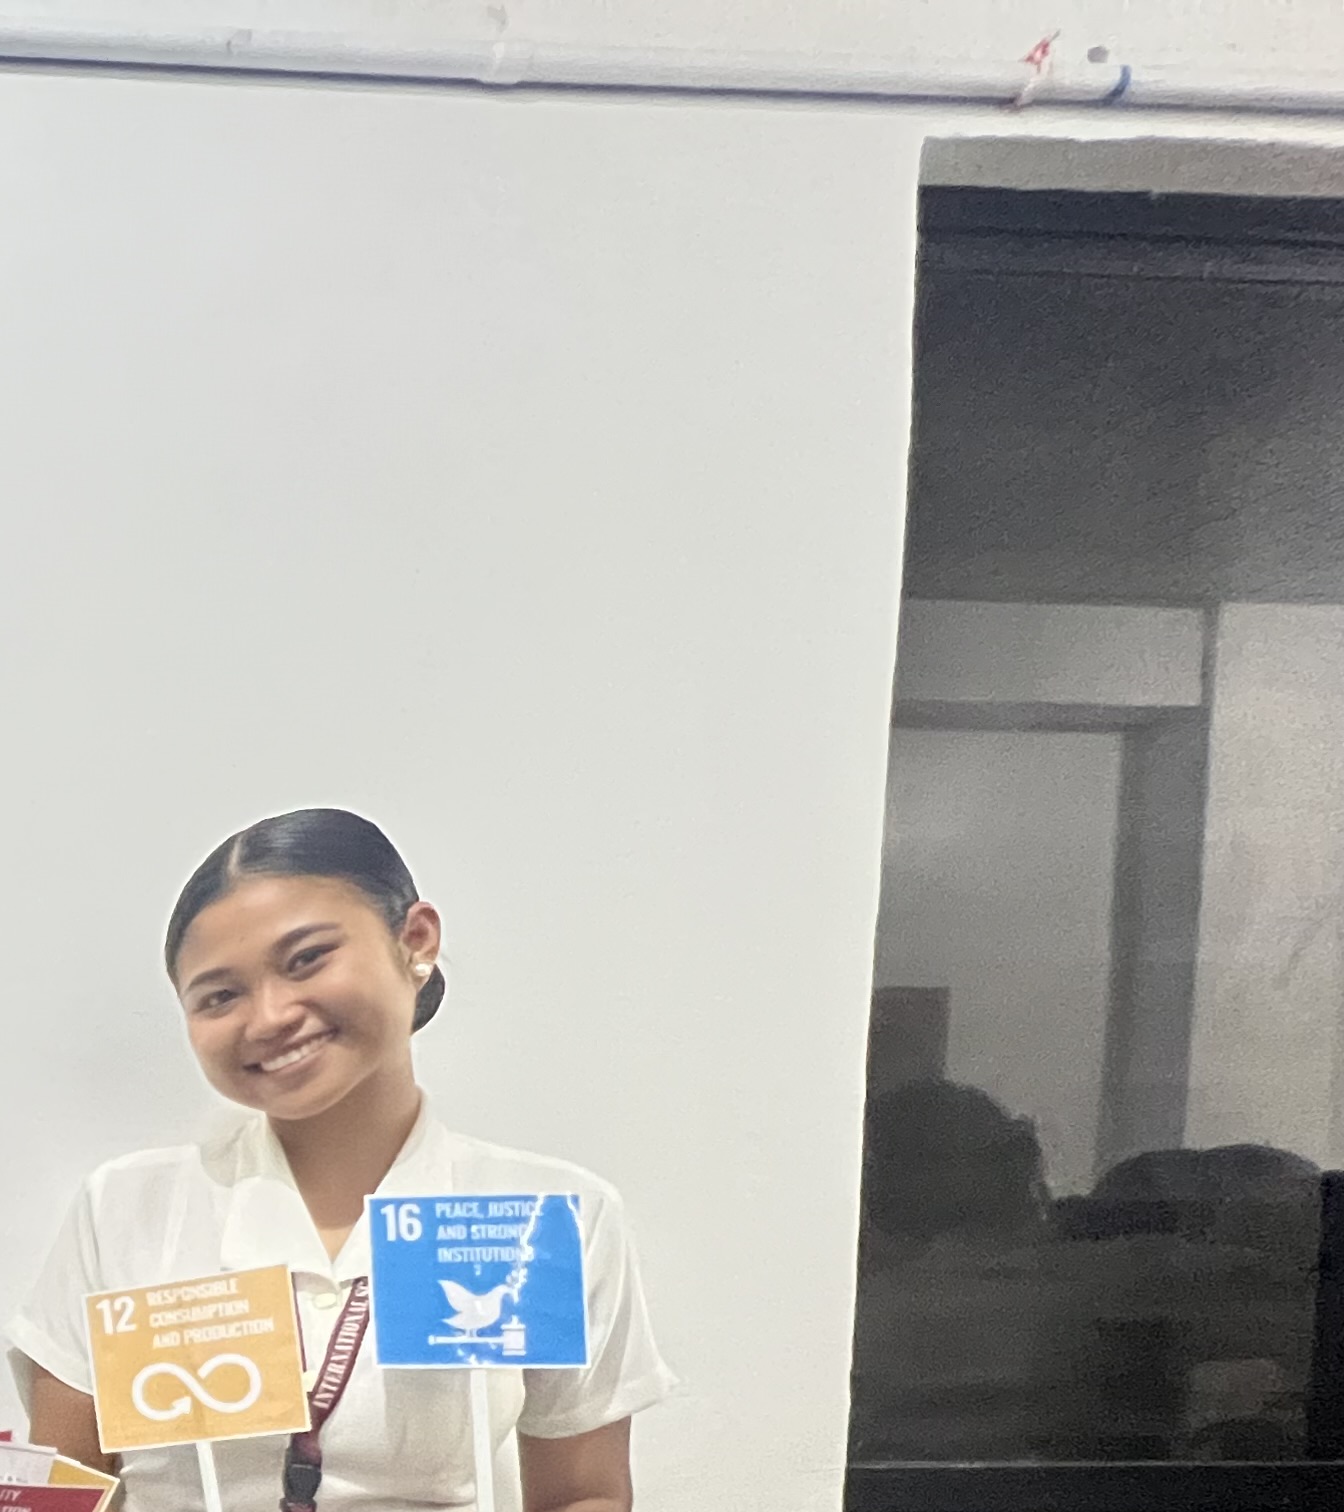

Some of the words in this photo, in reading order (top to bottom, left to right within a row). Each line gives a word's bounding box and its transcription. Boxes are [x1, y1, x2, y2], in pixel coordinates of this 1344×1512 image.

[381, 1203, 422, 1242] 16
[436, 1203, 483, 1219] PEACE,
[437, 1225, 465, 1240] AND
[146, 1278, 239, 1306] RESPONSIBLE
[96, 1297, 137, 1335] 12
[149, 1298, 249, 1328] CONSUMPTION
[152, 1329, 181, 1350] AND
[183, 1316, 274, 1346] PRODUCTION
